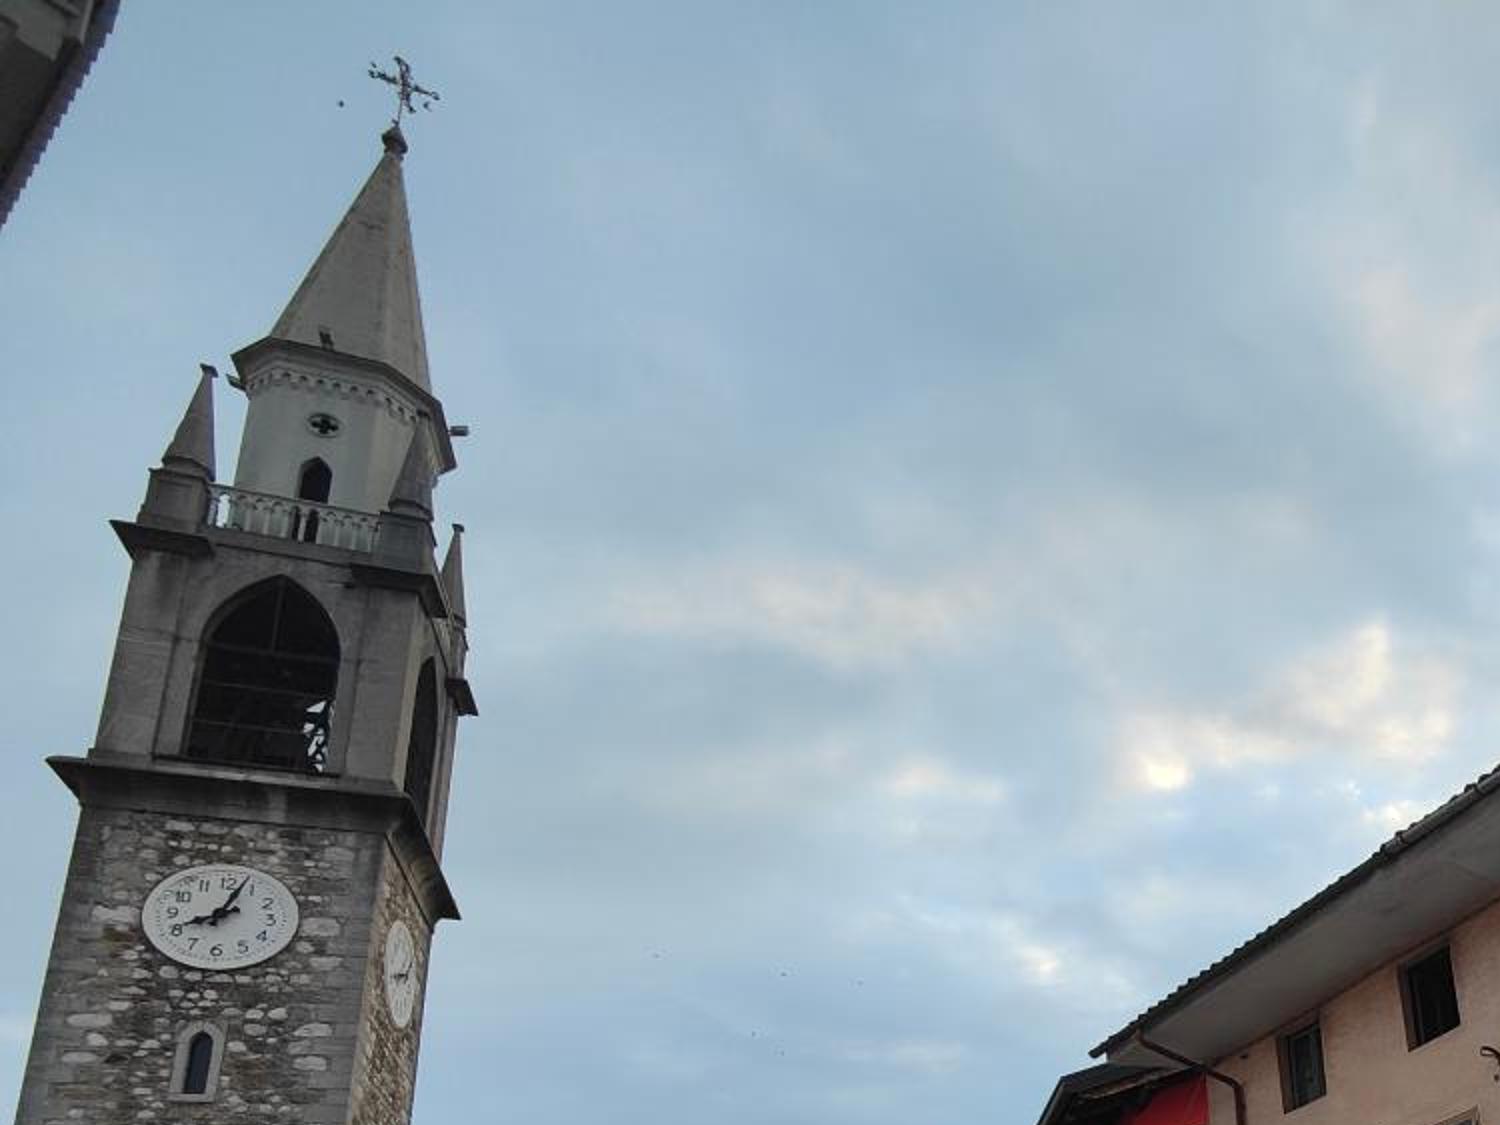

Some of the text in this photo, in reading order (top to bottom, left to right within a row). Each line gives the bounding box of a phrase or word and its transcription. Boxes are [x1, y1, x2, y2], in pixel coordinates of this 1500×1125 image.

[199, 879, 210, 892] 11
[221, 878, 238, 890] 12
[176, 891, 192, 902] 10
[262, 897, 275, 910] 2
[167, 907, 179, 918] 9
[265, 913, 277, 926] 3
[171, 923, 183, 936] 8
[256, 929, 268, 941] 4
[188, 937, 199, 950] 7
[210, 943, 223, 957] 6
[237, 940, 249, 954] 5
